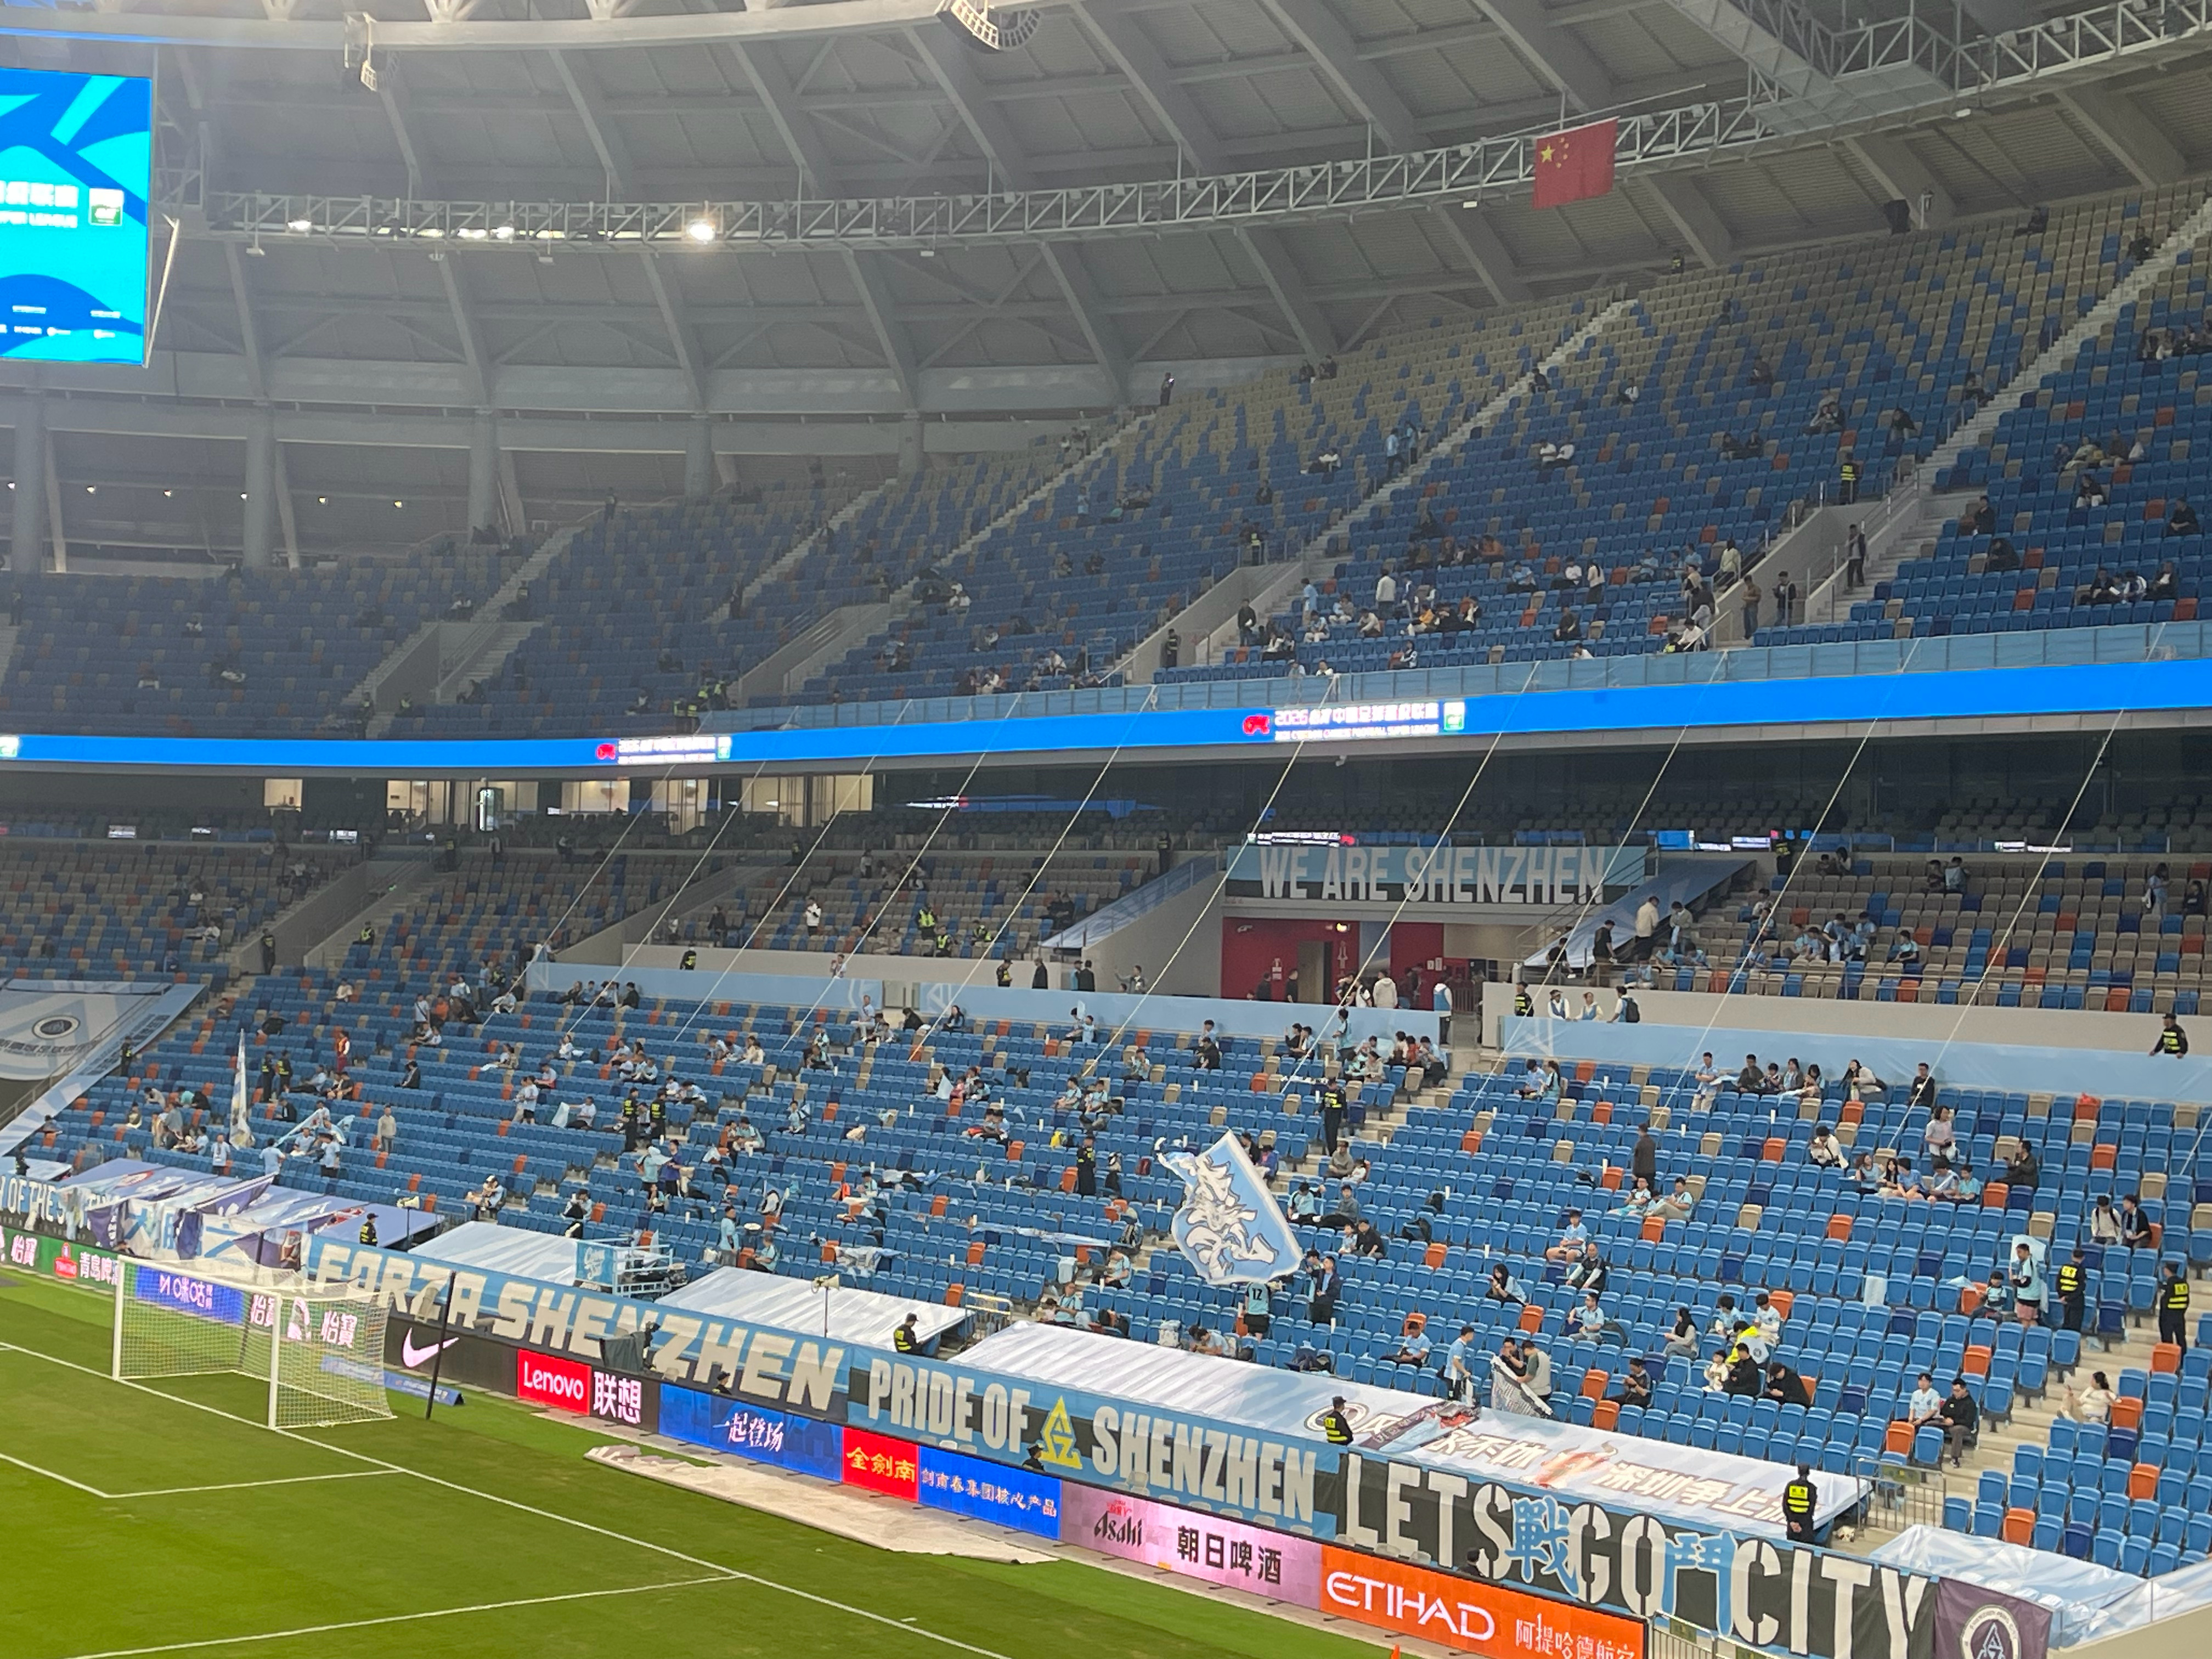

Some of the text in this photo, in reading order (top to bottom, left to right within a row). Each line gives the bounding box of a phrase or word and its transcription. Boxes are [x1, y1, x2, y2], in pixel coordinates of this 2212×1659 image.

[1260, 847, 1605, 904] WE ARE SHENZHEN
[7, 1177, 27, 1215] OF
[28, 1181, 55, 1222] THE
[314, 1243, 487, 1329] FORZA
[1251, 1288, 1262, 1301] 12
[524, 1361, 584, 1400] Lenovo
[594, 1371, 642, 1424] 联想
[713, 1412, 784, 1452] 一起登场
[868, 1358, 975, 1442] PRIDE
[982, 1383, 1031, 1453] OF
[1092, 1406, 1316, 1523] SHENZHEN
[1094, 1510, 1143, 1548] Asahi
[1177, 1525, 1282, 1585] 朝日啤酒
[1347, 1452, 1513, 1580] LETS
[1567, 1503, 1667, 1617] GO
[1731, 1538, 1929, 1659] CITY
[1327, 1571, 1495, 1641] ETIHAD
